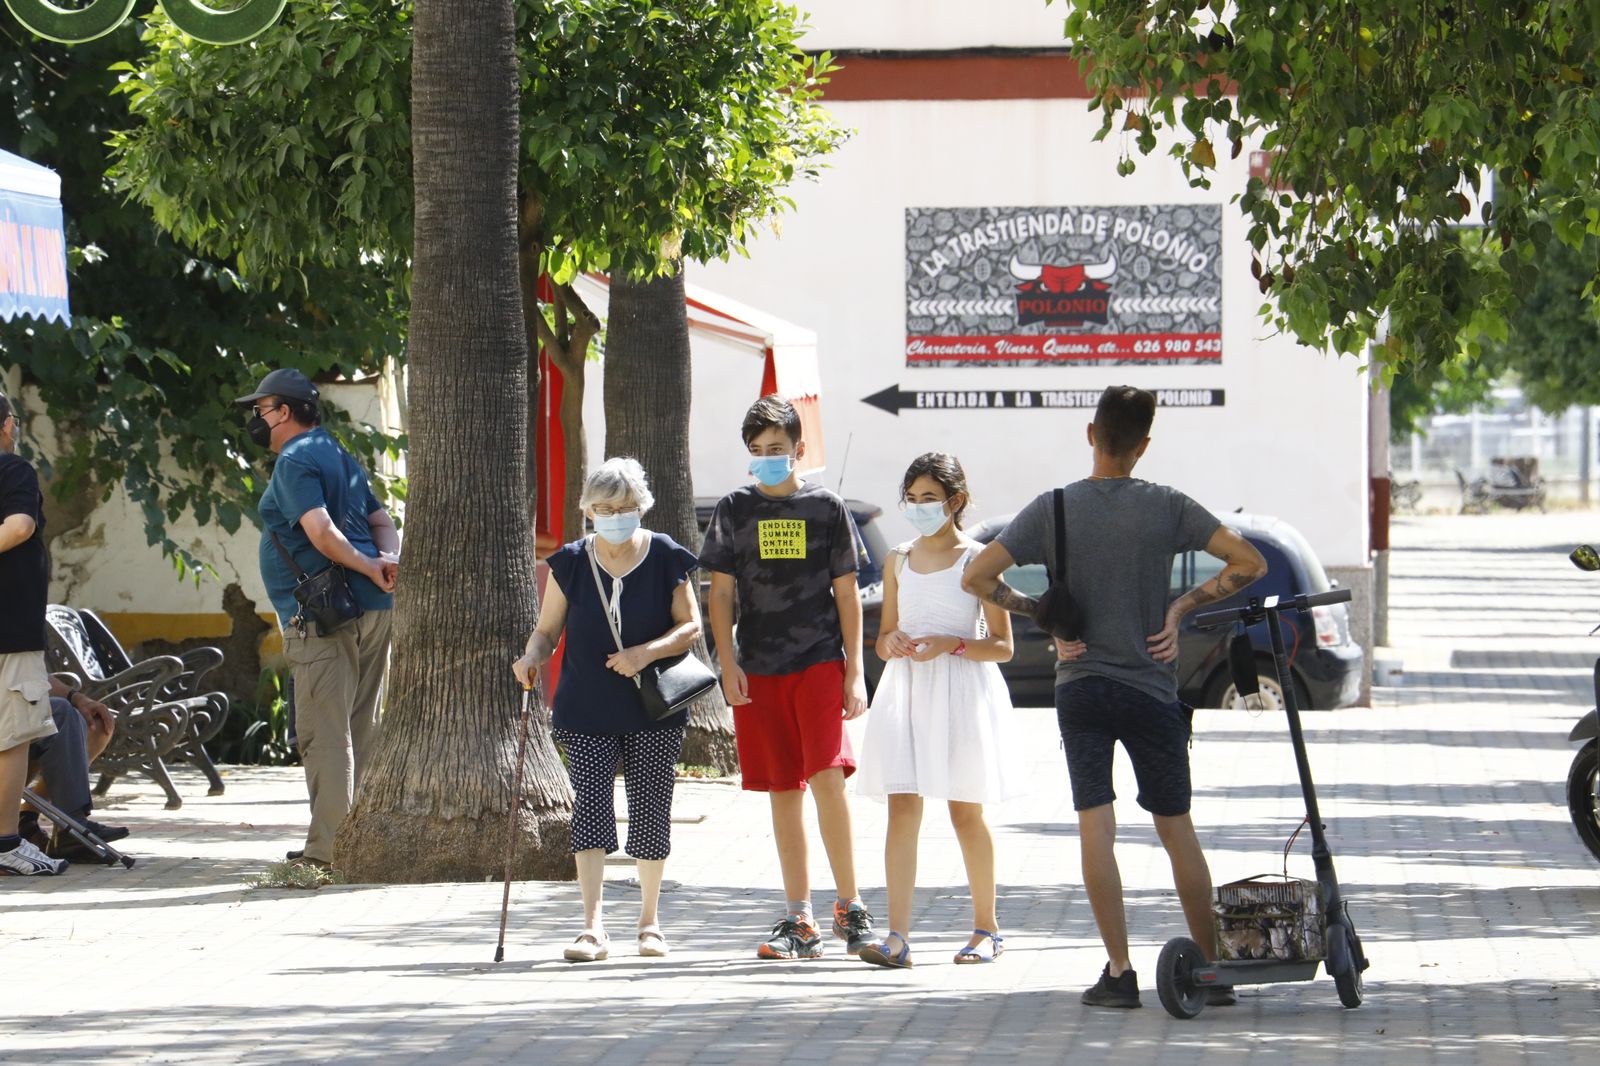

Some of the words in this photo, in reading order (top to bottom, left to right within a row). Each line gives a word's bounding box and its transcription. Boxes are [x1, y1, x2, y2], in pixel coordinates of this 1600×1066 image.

[919, 250, 949, 278] LA
[947, 213, 1075, 258] TRASTIENDA
[1081, 213, 1108, 236] DE
[1113, 217, 1208, 273] POLONIO
[1019, 298, 1107, 316] POLONIO
[1133, 340, 1161, 353] 626
[1164, 340, 1192, 353] 980
[1194, 339, 1221, 353] 543
[916, 392, 988, 408] ENTRADA
[994, 391, 1005, 407] A
[1015, 391, 1032, 407] LA
[1156, 390, 1213, 406] POLONIO
